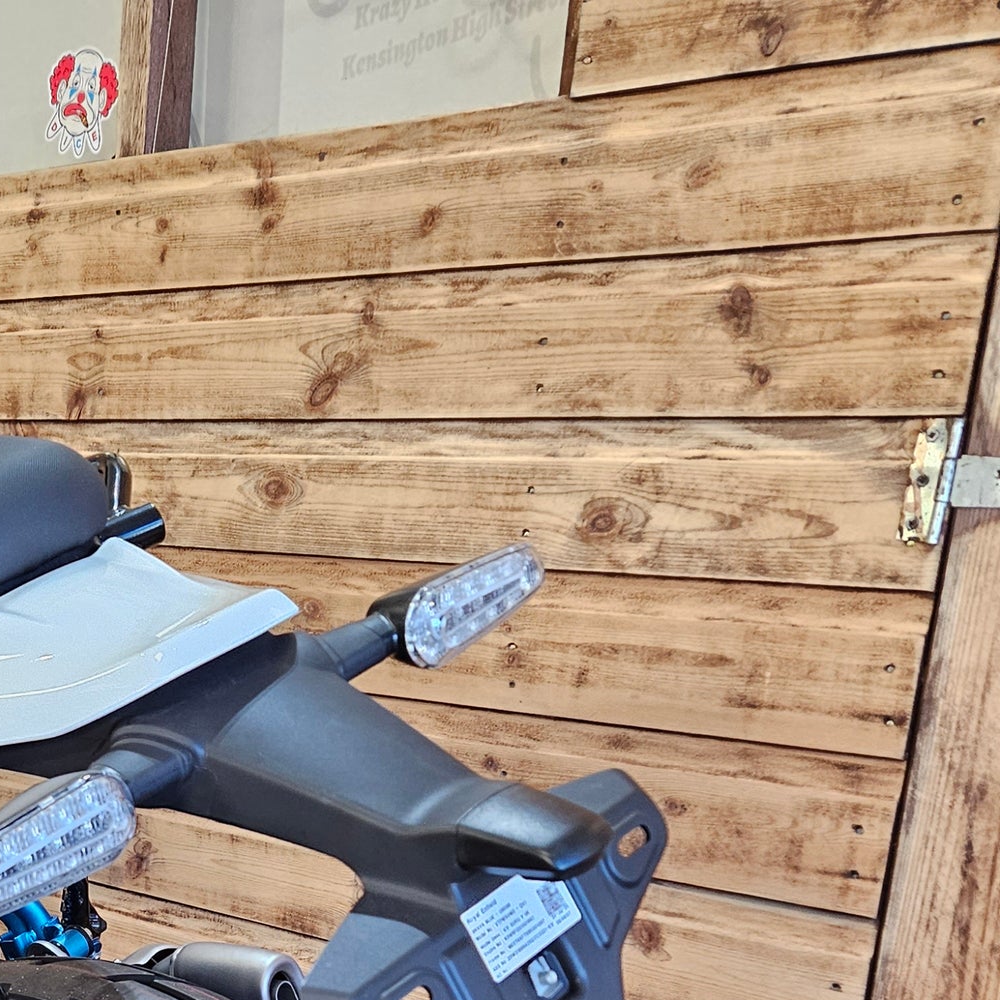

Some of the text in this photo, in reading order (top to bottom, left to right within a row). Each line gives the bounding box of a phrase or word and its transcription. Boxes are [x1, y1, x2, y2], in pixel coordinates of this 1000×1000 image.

[340, 26, 450, 81] Kensington
[449, 1, 502, 43] High
[354, 0, 410, 30] Krazy
